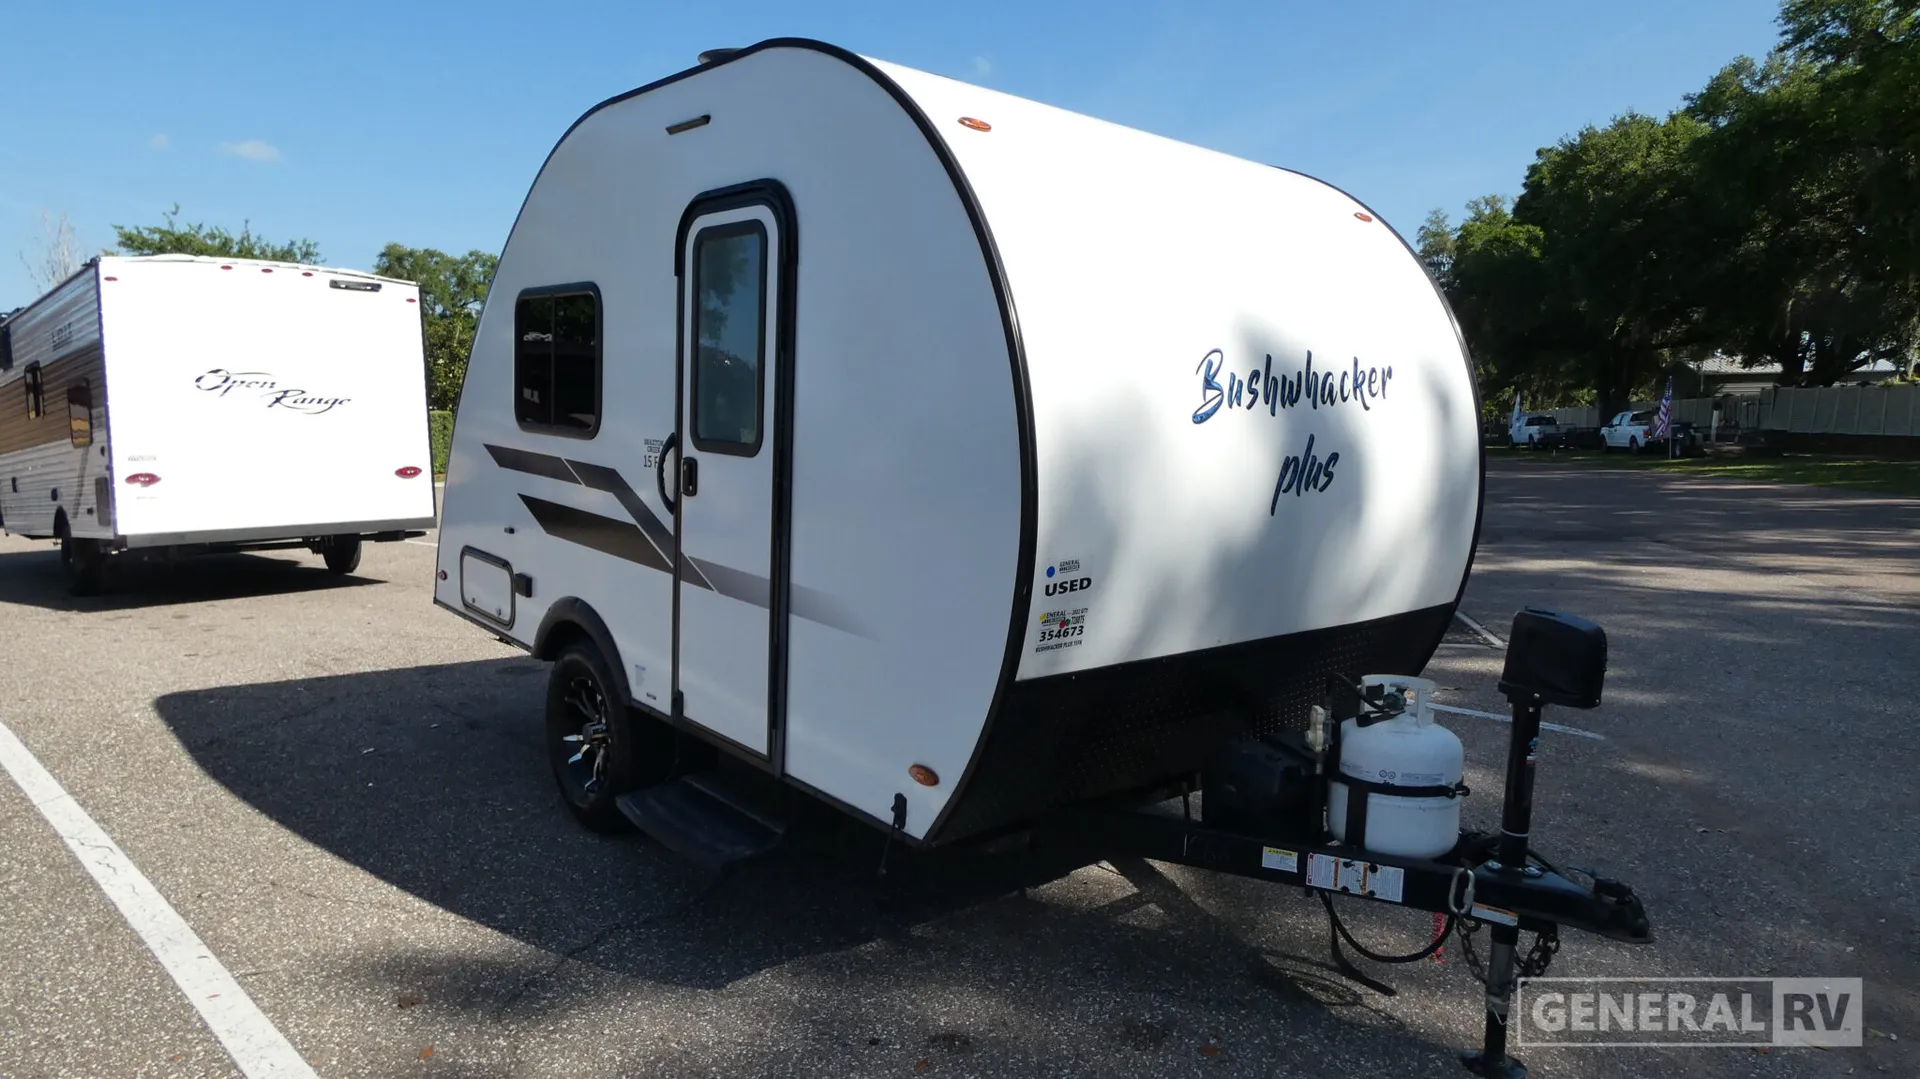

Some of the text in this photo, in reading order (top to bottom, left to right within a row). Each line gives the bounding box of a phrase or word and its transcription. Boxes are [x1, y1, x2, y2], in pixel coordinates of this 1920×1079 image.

[195, 368, 278, 397] Open
[1192, 347, 1393, 425] Bushwhacker
[262, 389, 352, 415] Range
[643, 454, 653, 468] 15
[1270, 433, 1340, 517] plus
[1044, 577, 1092, 597] USED
[1039, 625, 1084, 643] 354673
